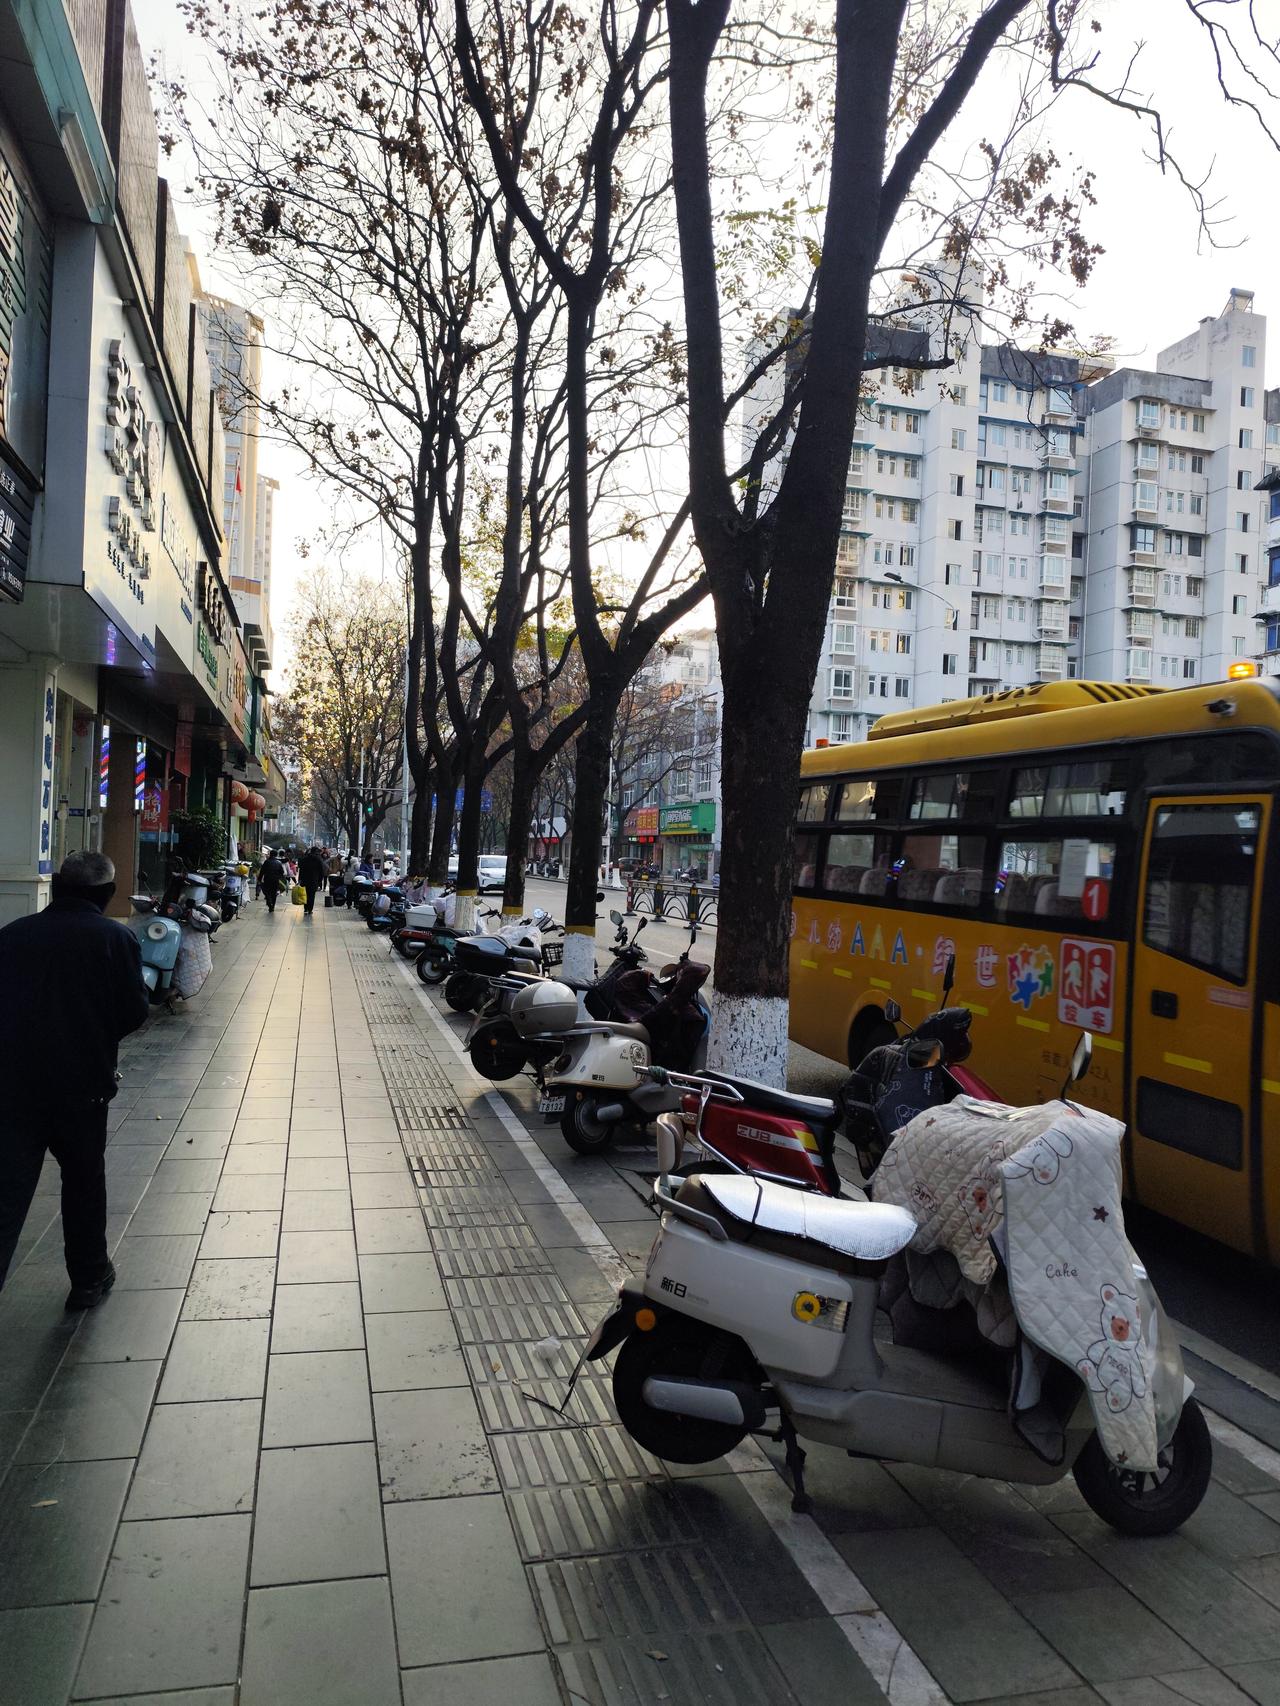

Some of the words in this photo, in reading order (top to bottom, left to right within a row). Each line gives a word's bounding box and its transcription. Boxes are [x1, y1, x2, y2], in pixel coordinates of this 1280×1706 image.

[1088, 884, 1100, 917] 1
[1064, 1004, 1106, 1029] 校车
[660, 1276, 688, 1298] 新日
